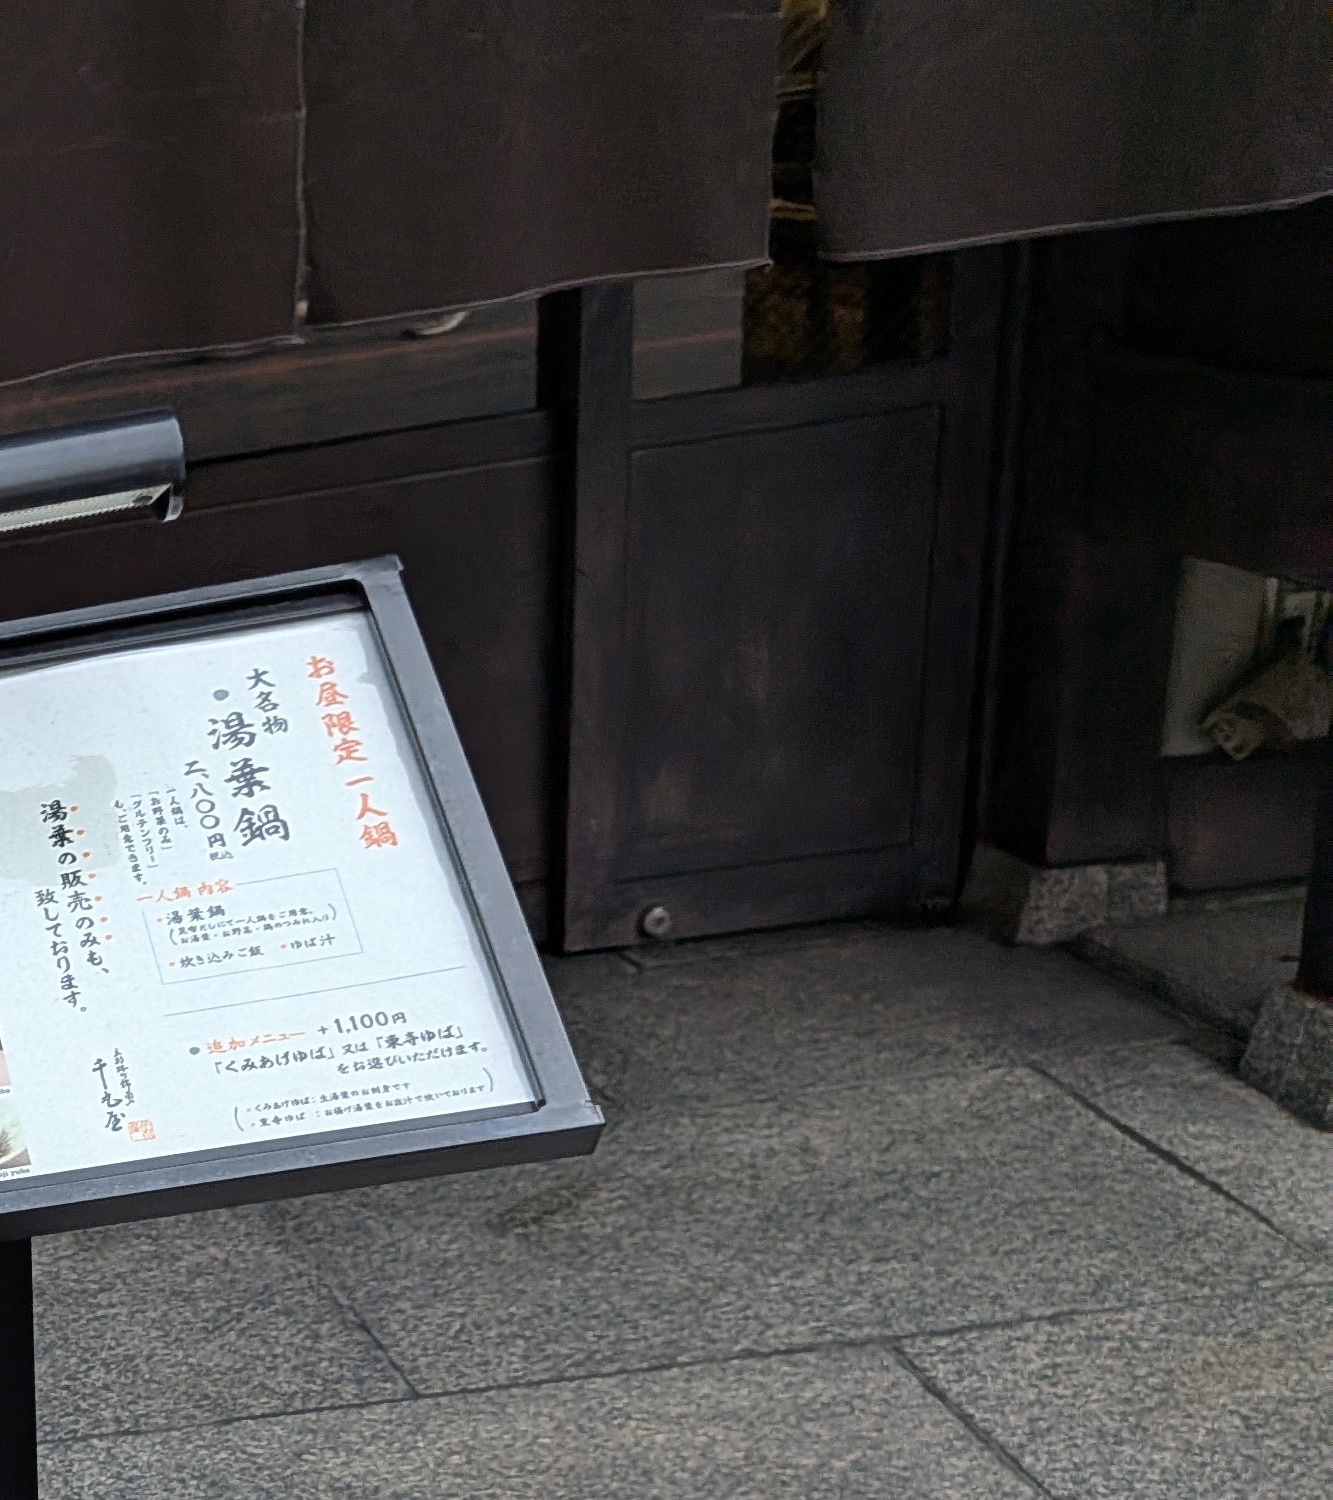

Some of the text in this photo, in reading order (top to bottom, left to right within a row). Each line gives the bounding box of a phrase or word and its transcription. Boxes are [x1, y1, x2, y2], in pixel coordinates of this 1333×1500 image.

[246, 668, 289, 735] 大名物
[306, 655, 398, 849] お昼限定一人鍋
[207, 711, 290, 847] 湯葉鍋
[180, 934, 335, 968] 炊き込みご飯 ゆば汁
[207, 1032, 306, 1054] 追加メニュー
[337, 1042, 487, 1074] をお選びいただけます。
[11, 1168, 31, 1177] yuba
